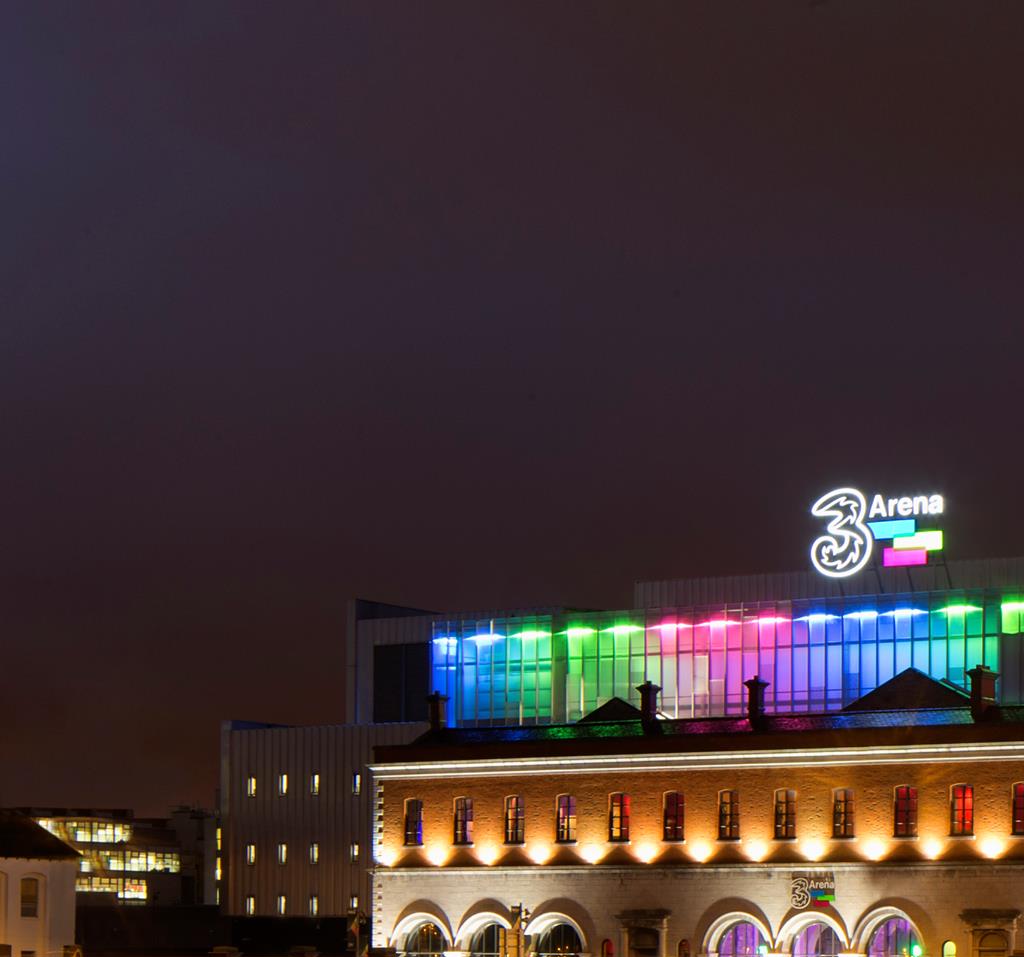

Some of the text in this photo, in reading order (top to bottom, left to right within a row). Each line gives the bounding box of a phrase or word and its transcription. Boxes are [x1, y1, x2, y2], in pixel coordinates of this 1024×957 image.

[811, 488, 944, 578] 3 Arena
[791, 877, 834, 909] 3 Arena
